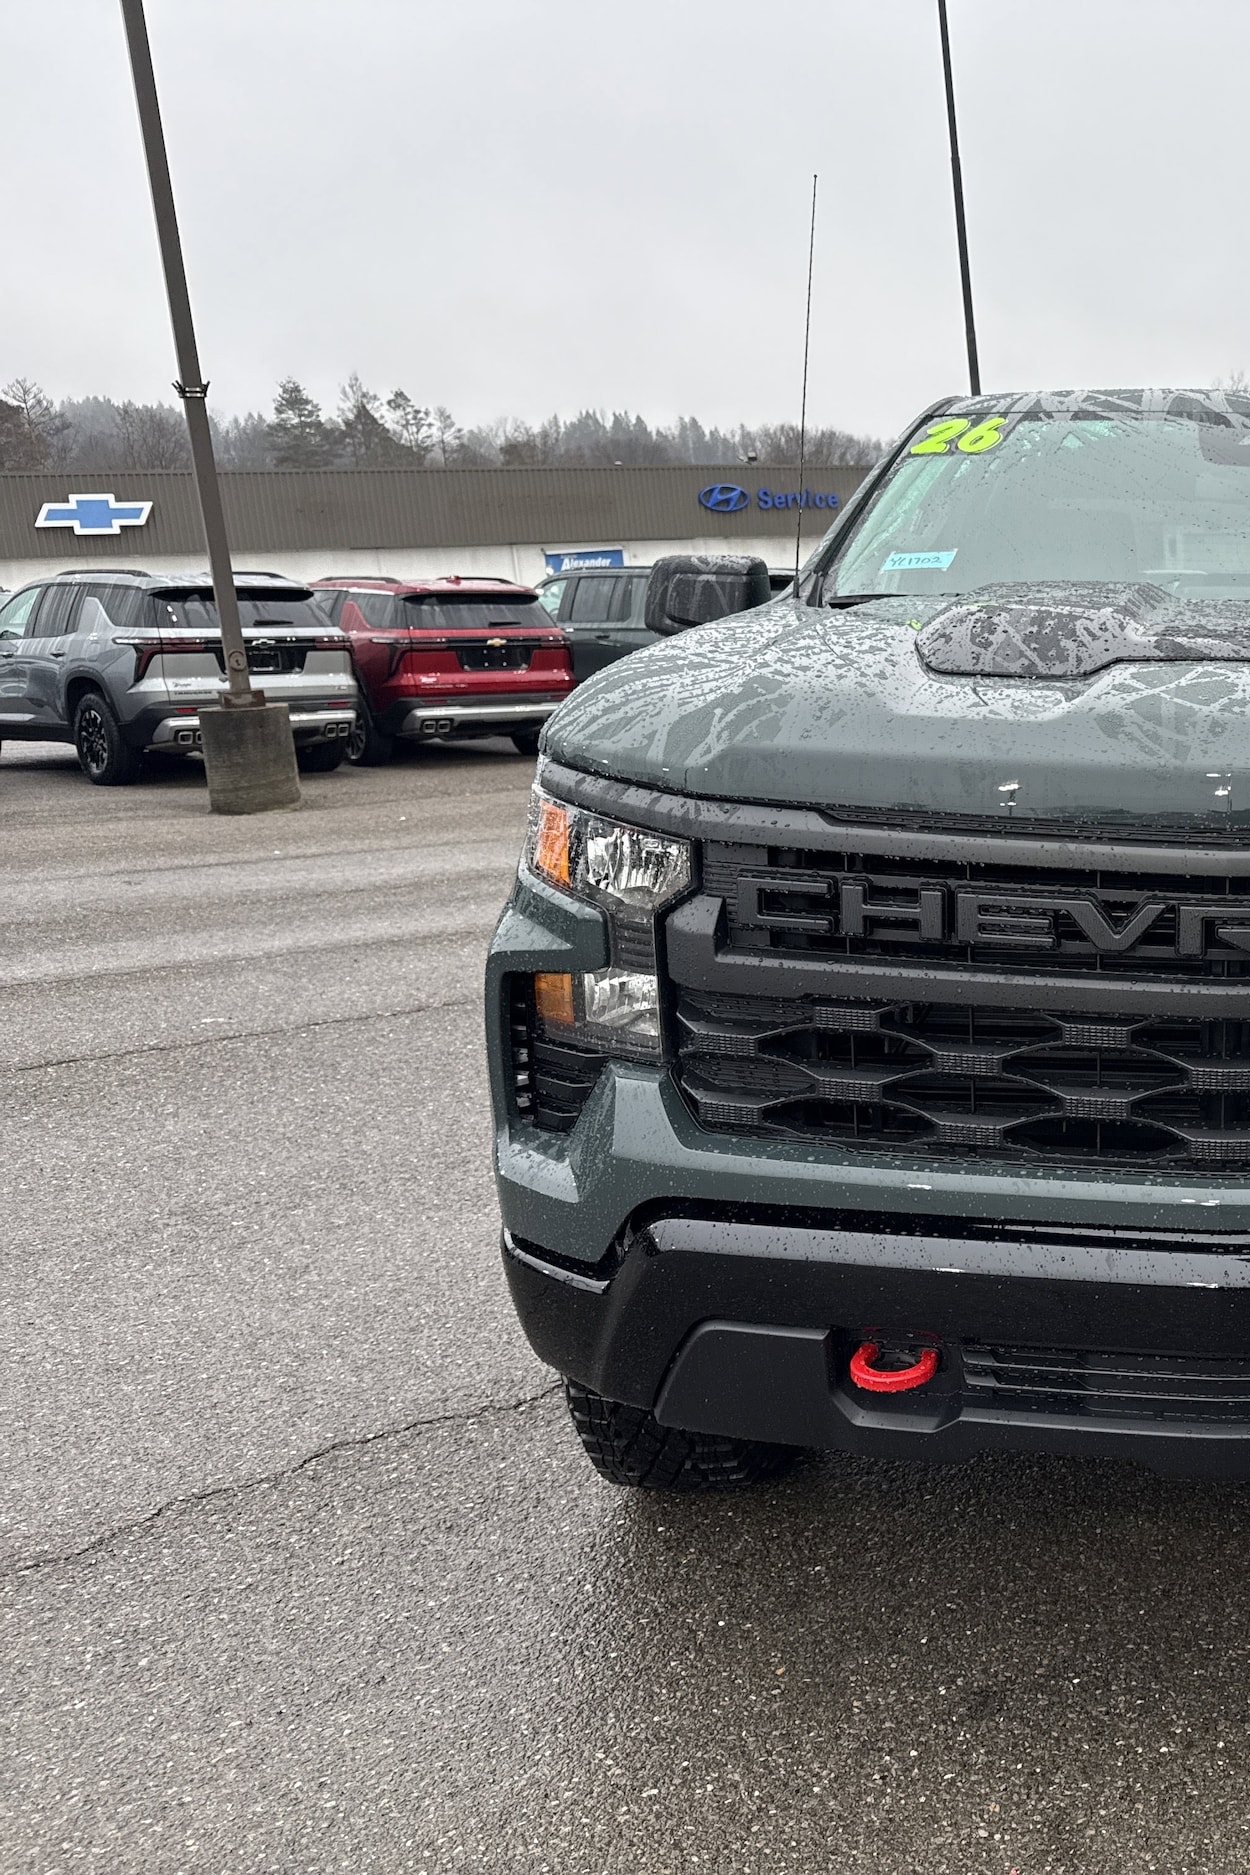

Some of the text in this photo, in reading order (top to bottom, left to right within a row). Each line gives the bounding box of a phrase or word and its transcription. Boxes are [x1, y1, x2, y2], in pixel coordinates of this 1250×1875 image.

[910, 417, 1008, 454] 26
[757, 487, 838, 510] Service
[561, 557, 612, 571] Alexander
